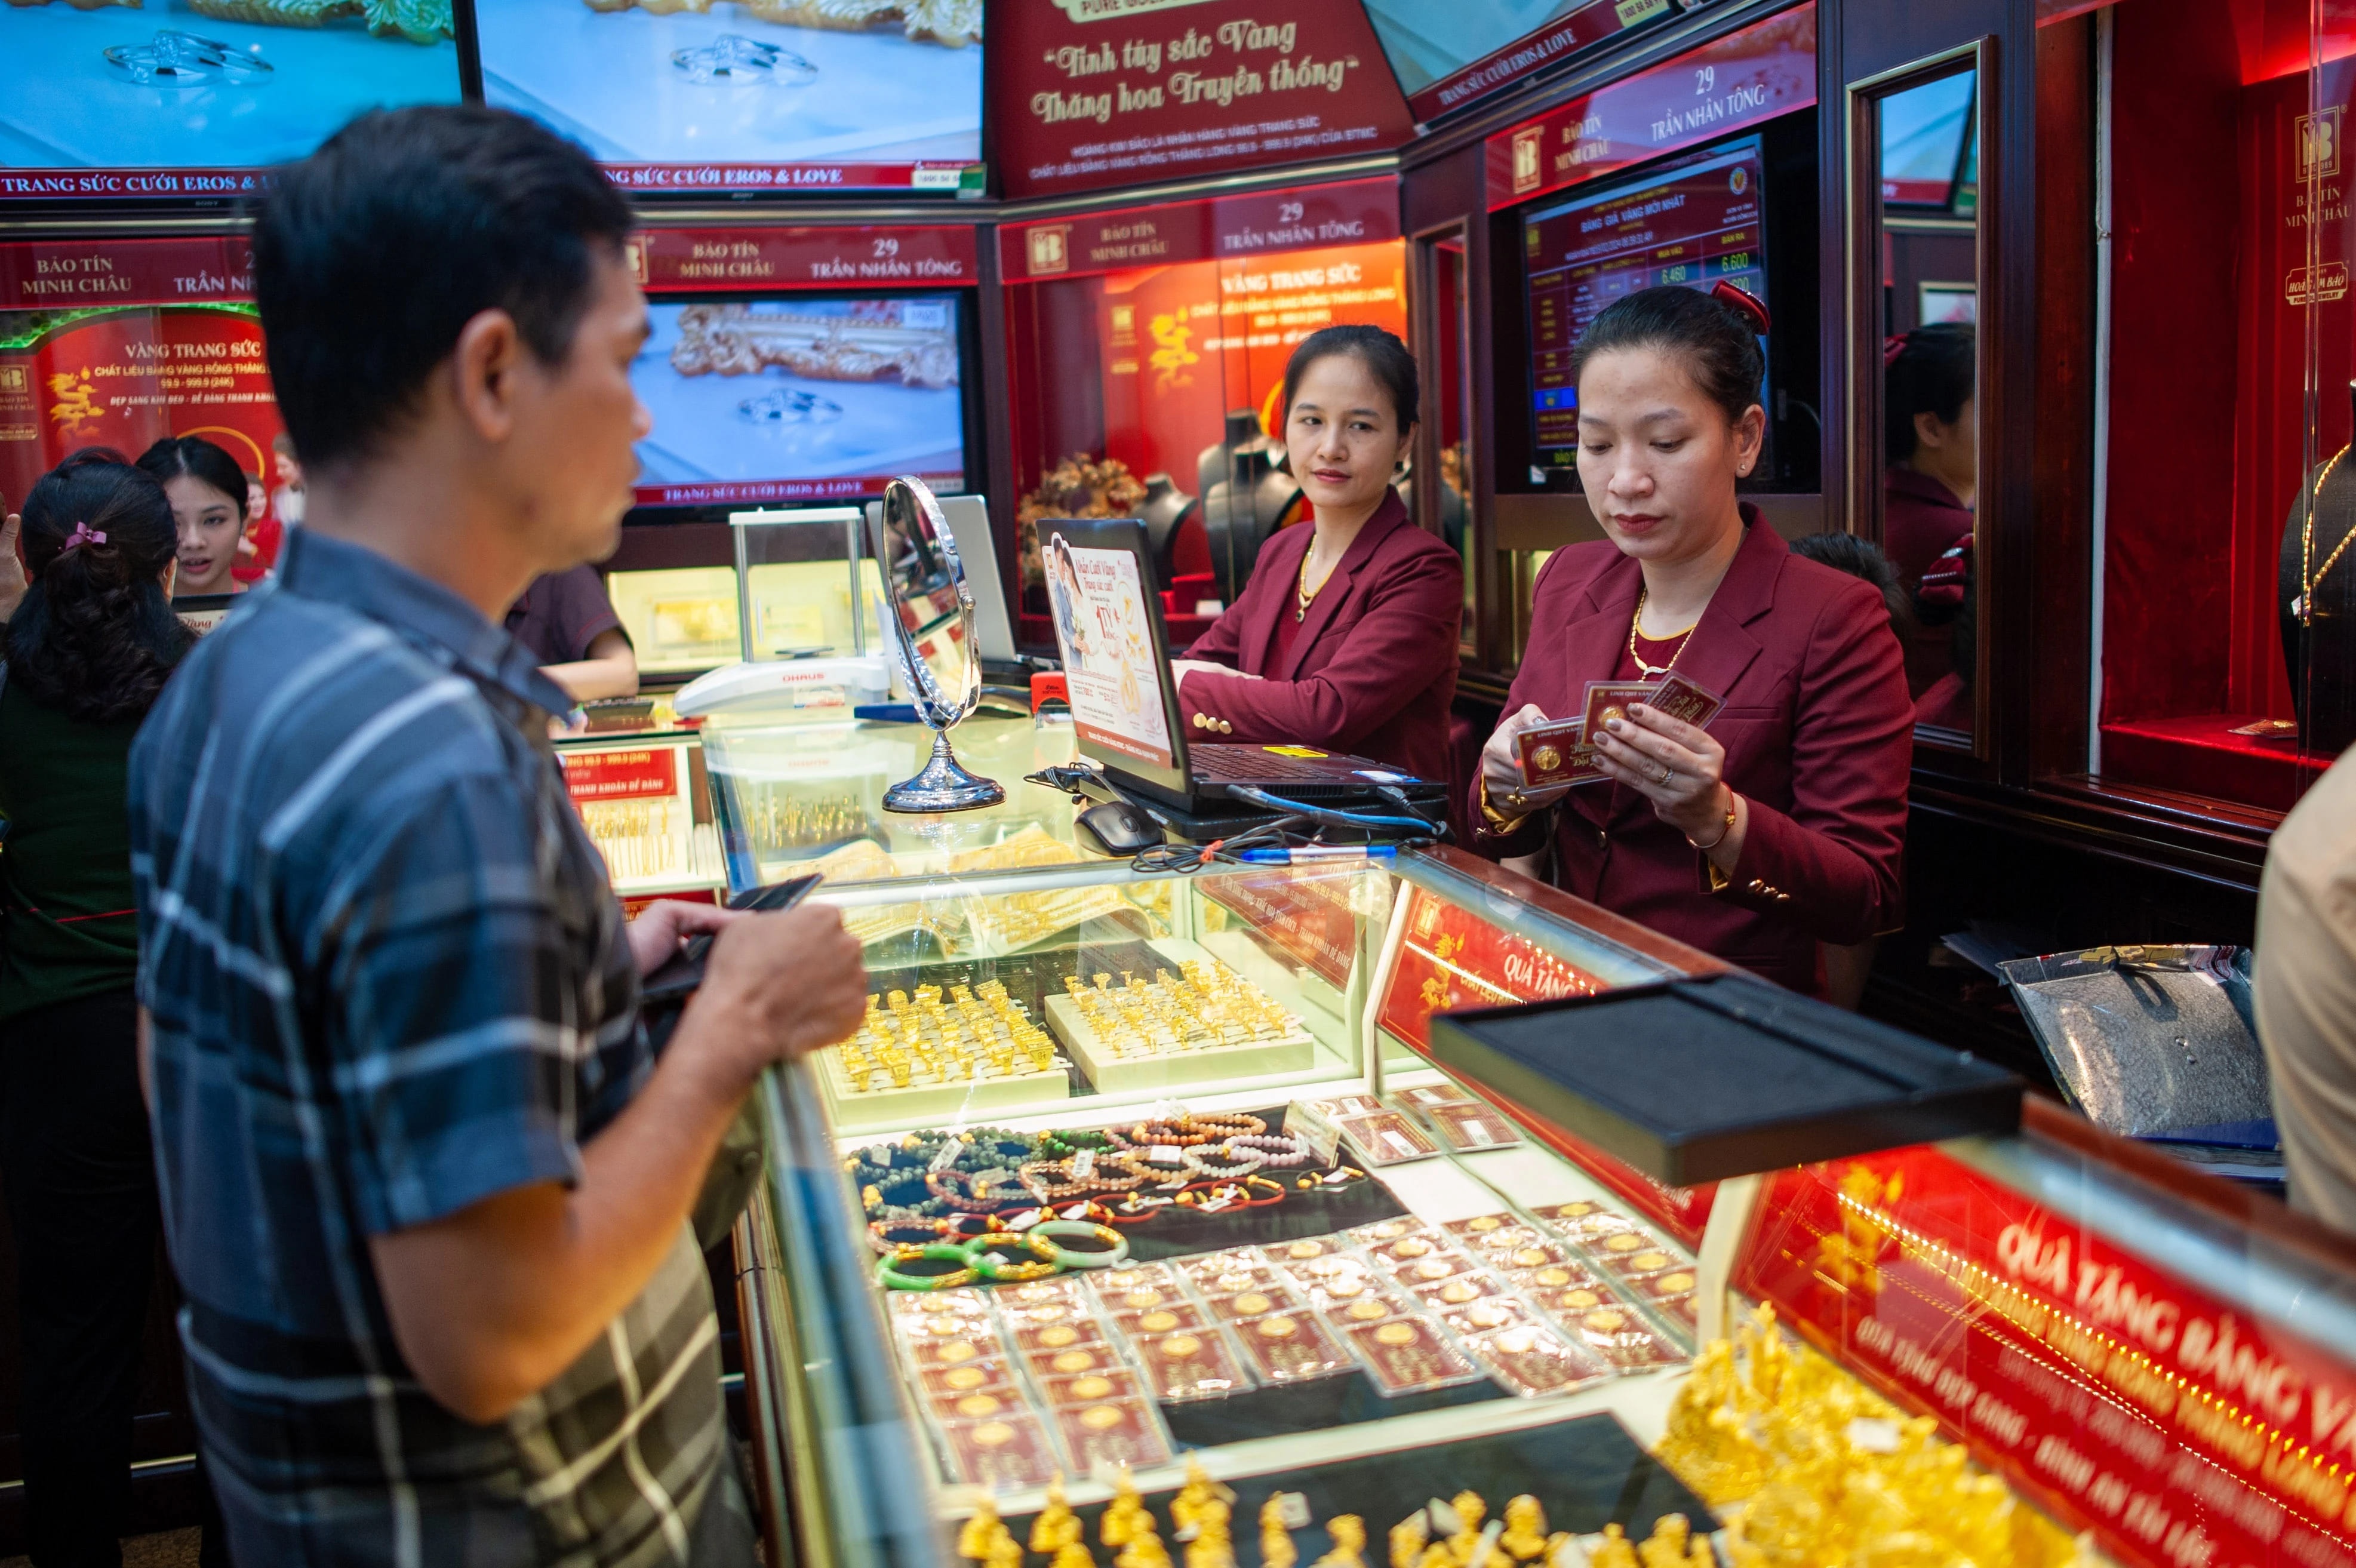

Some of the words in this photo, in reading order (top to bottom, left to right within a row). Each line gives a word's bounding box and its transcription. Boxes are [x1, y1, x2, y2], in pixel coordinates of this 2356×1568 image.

[1168, 28, 1213, 62] sắc
[1217, 20, 1297, 60] Vàng
[1544, 28, 1577, 54] LOVE
[1694, 64, 1715, 96] 29
[1118, 82, 1165, 113] hoa
[1650, 107, 1683, 143] TRẦN
[1685, 94, 1724, 133] NHÂN
[1726, 84, 1766, 117] TÔNG
[2, 178, 75, 192] TRANG
[80, 174, 121, 192] SỨC
[125, 174, 179, 192] CƯỚI
[183, 175, 237, 191] EROS
[241, 176, 256, 190] &
[633, 167, 670, 185] SỨC
[674, 167, 721, 185] CƯỚI
[724, 168, 773, 185] EROS
[776, 169, 790, 184] &
[793, 168, 843, 184] LOVE
[1279, 202, 1304, 223] 29
[1224, 231, 1265, 251] TRẦN
[1267, 226, 1315, 247] NHÂN
[1317, 219, 1364, 240] TÔNG
[731, 240, 760, 257] TÍN
[873, 238, 899, 257] 29
[36, 256, 77, 274] BẢO
[80, 254, 113, 273] TÍN
[679, 262, 724, 278] MINH
[810, 259, 856, 279] TRẦN
[859, 257, 912, 278] NHÂN
[915, 258, 962, 276] TÔNG
[1721, 252, 1749, 273] 6.600
[22, 277, 75, 294] MINH
[78, 275, 133, 293] CHÂU
[173, 270, 225, 293] TRẦN
[1221, 272, 1268, 294] VÀNG
[1269, 268, 1325, 290] TRANG
[1661, 265, 1686, 285] 6.460
[124, 341, 170, 358] VÀNG
[173, 342, 227, 358] TRANG
[230, 339, 262, 358] SỨC
[94, 363, 121, 377] CHẤT
[176, 362, 204, 375] VÀNG
[783, 673, 825, 682] OHAUS
[570, 783, 597, 796] THANH
[1297, 926, 1315, 945] THANH
[1996, 1223, 2072, 1296] QUÀ
